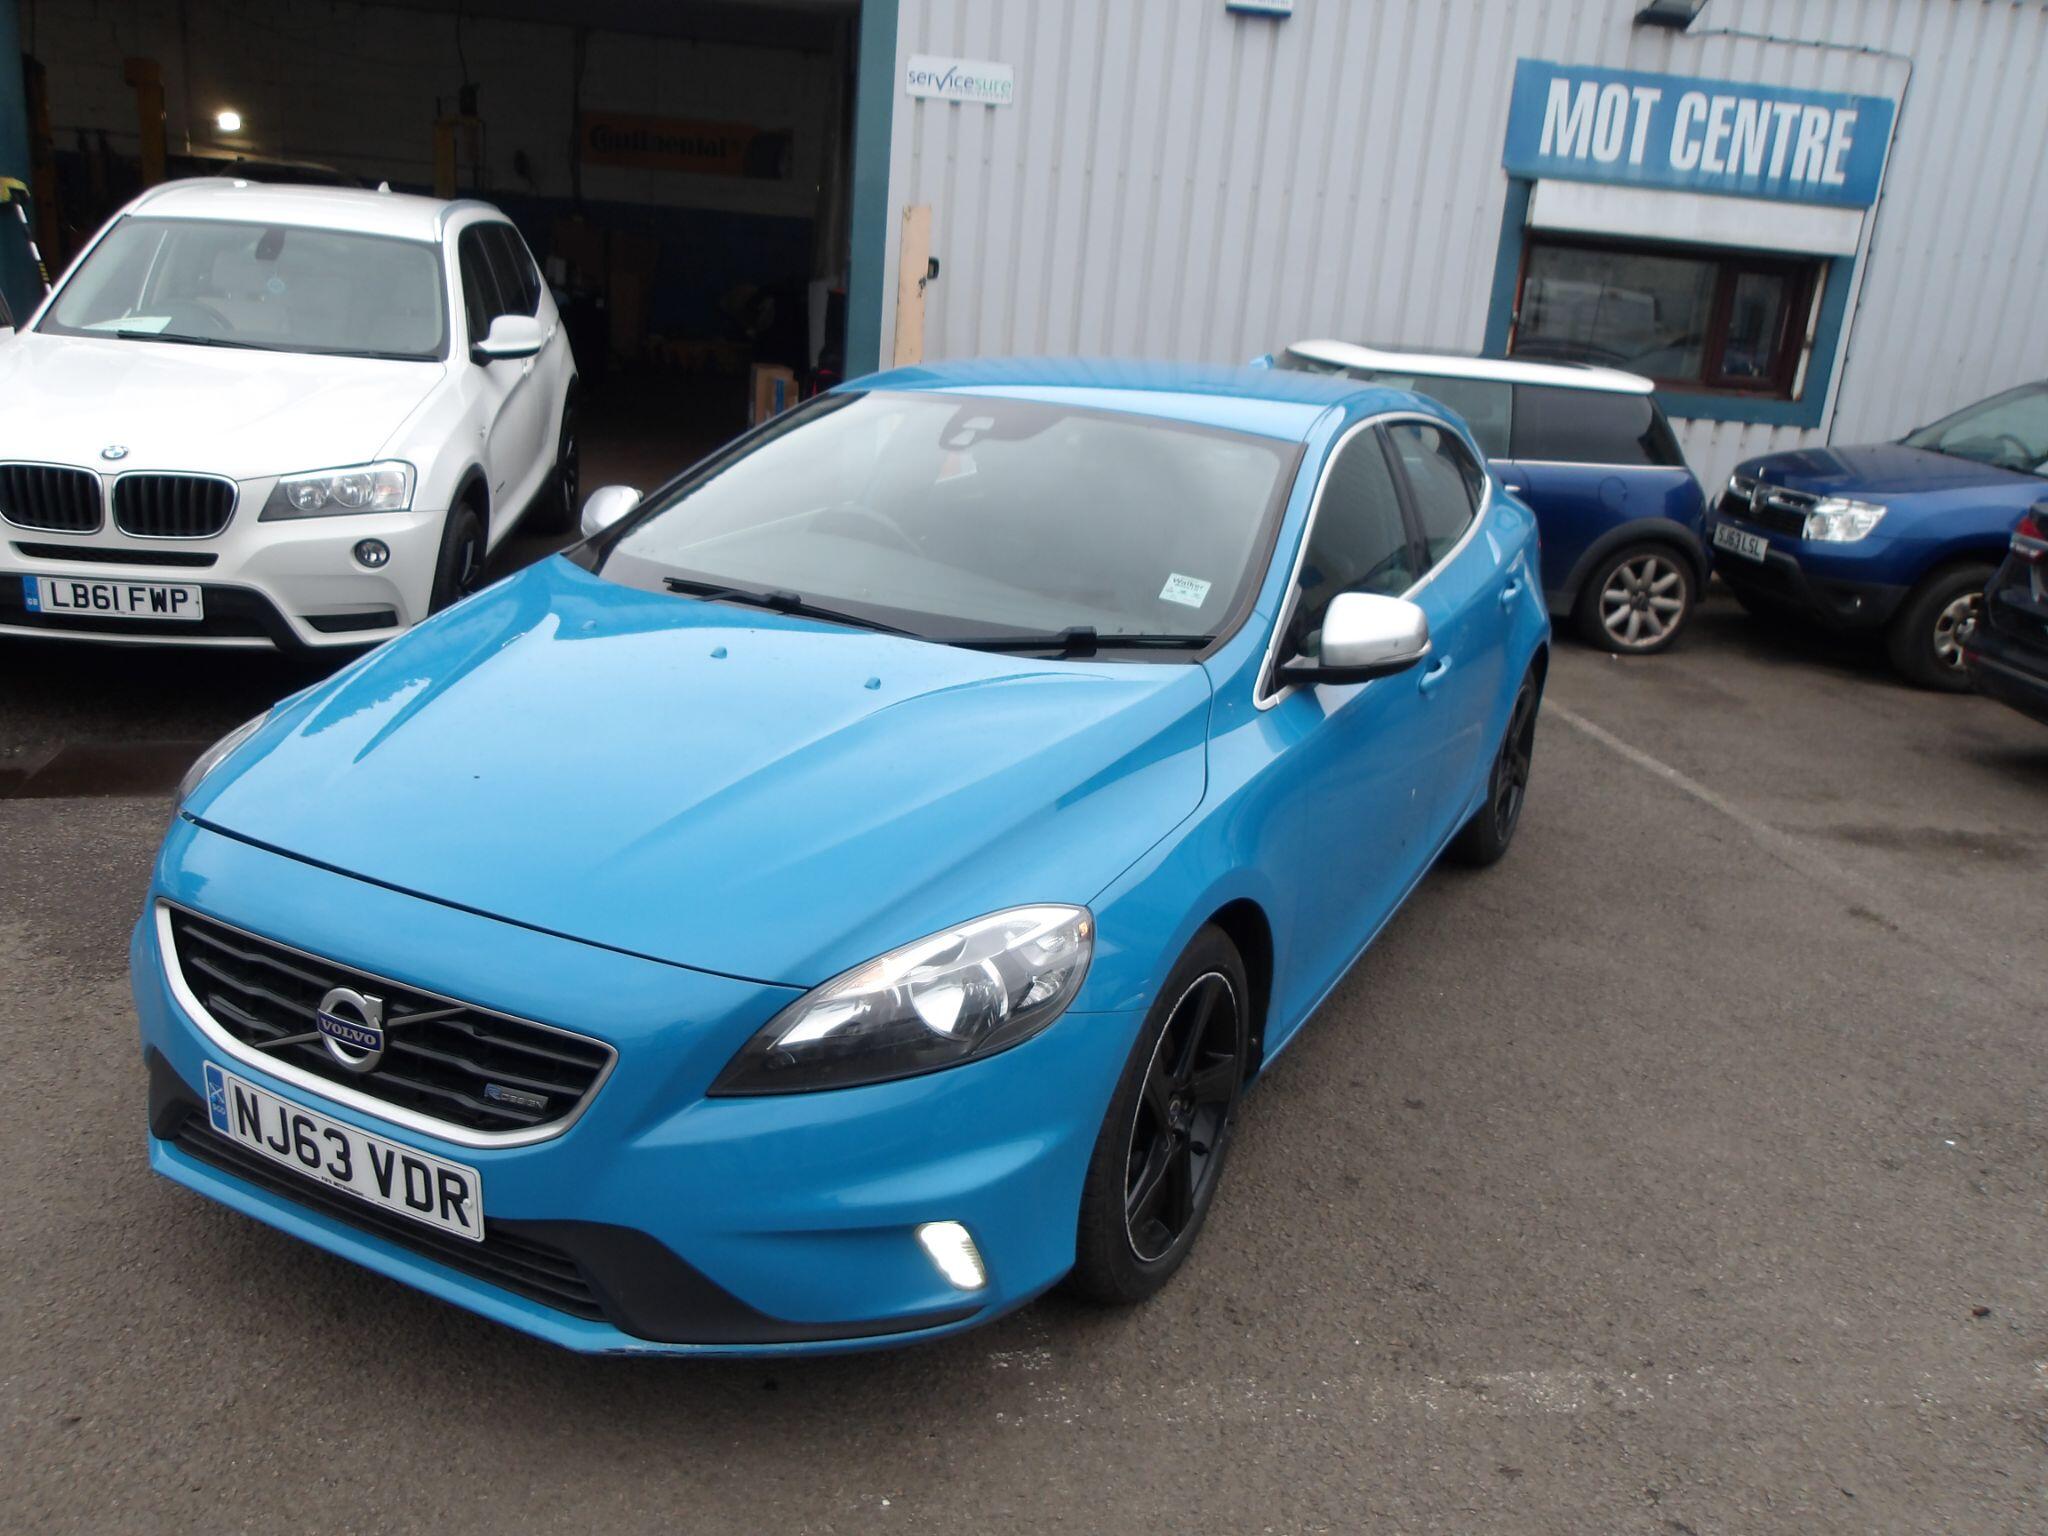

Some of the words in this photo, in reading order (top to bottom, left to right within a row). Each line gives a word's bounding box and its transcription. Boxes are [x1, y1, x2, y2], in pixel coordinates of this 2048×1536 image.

[908, 65, 1011, 93] servicesure
[1538, 78, 1662, 166] MOT
[1669, 91, 1857, 186] CENTRE
[51, 581, 119, 611] LB61
[128, 586, 188, 613] FWP
[320, 1017, 377, 1046] VOLVO
[234, 1085, 353, 1183] NJ63
[367, 1141, 471, 1228] VDR
